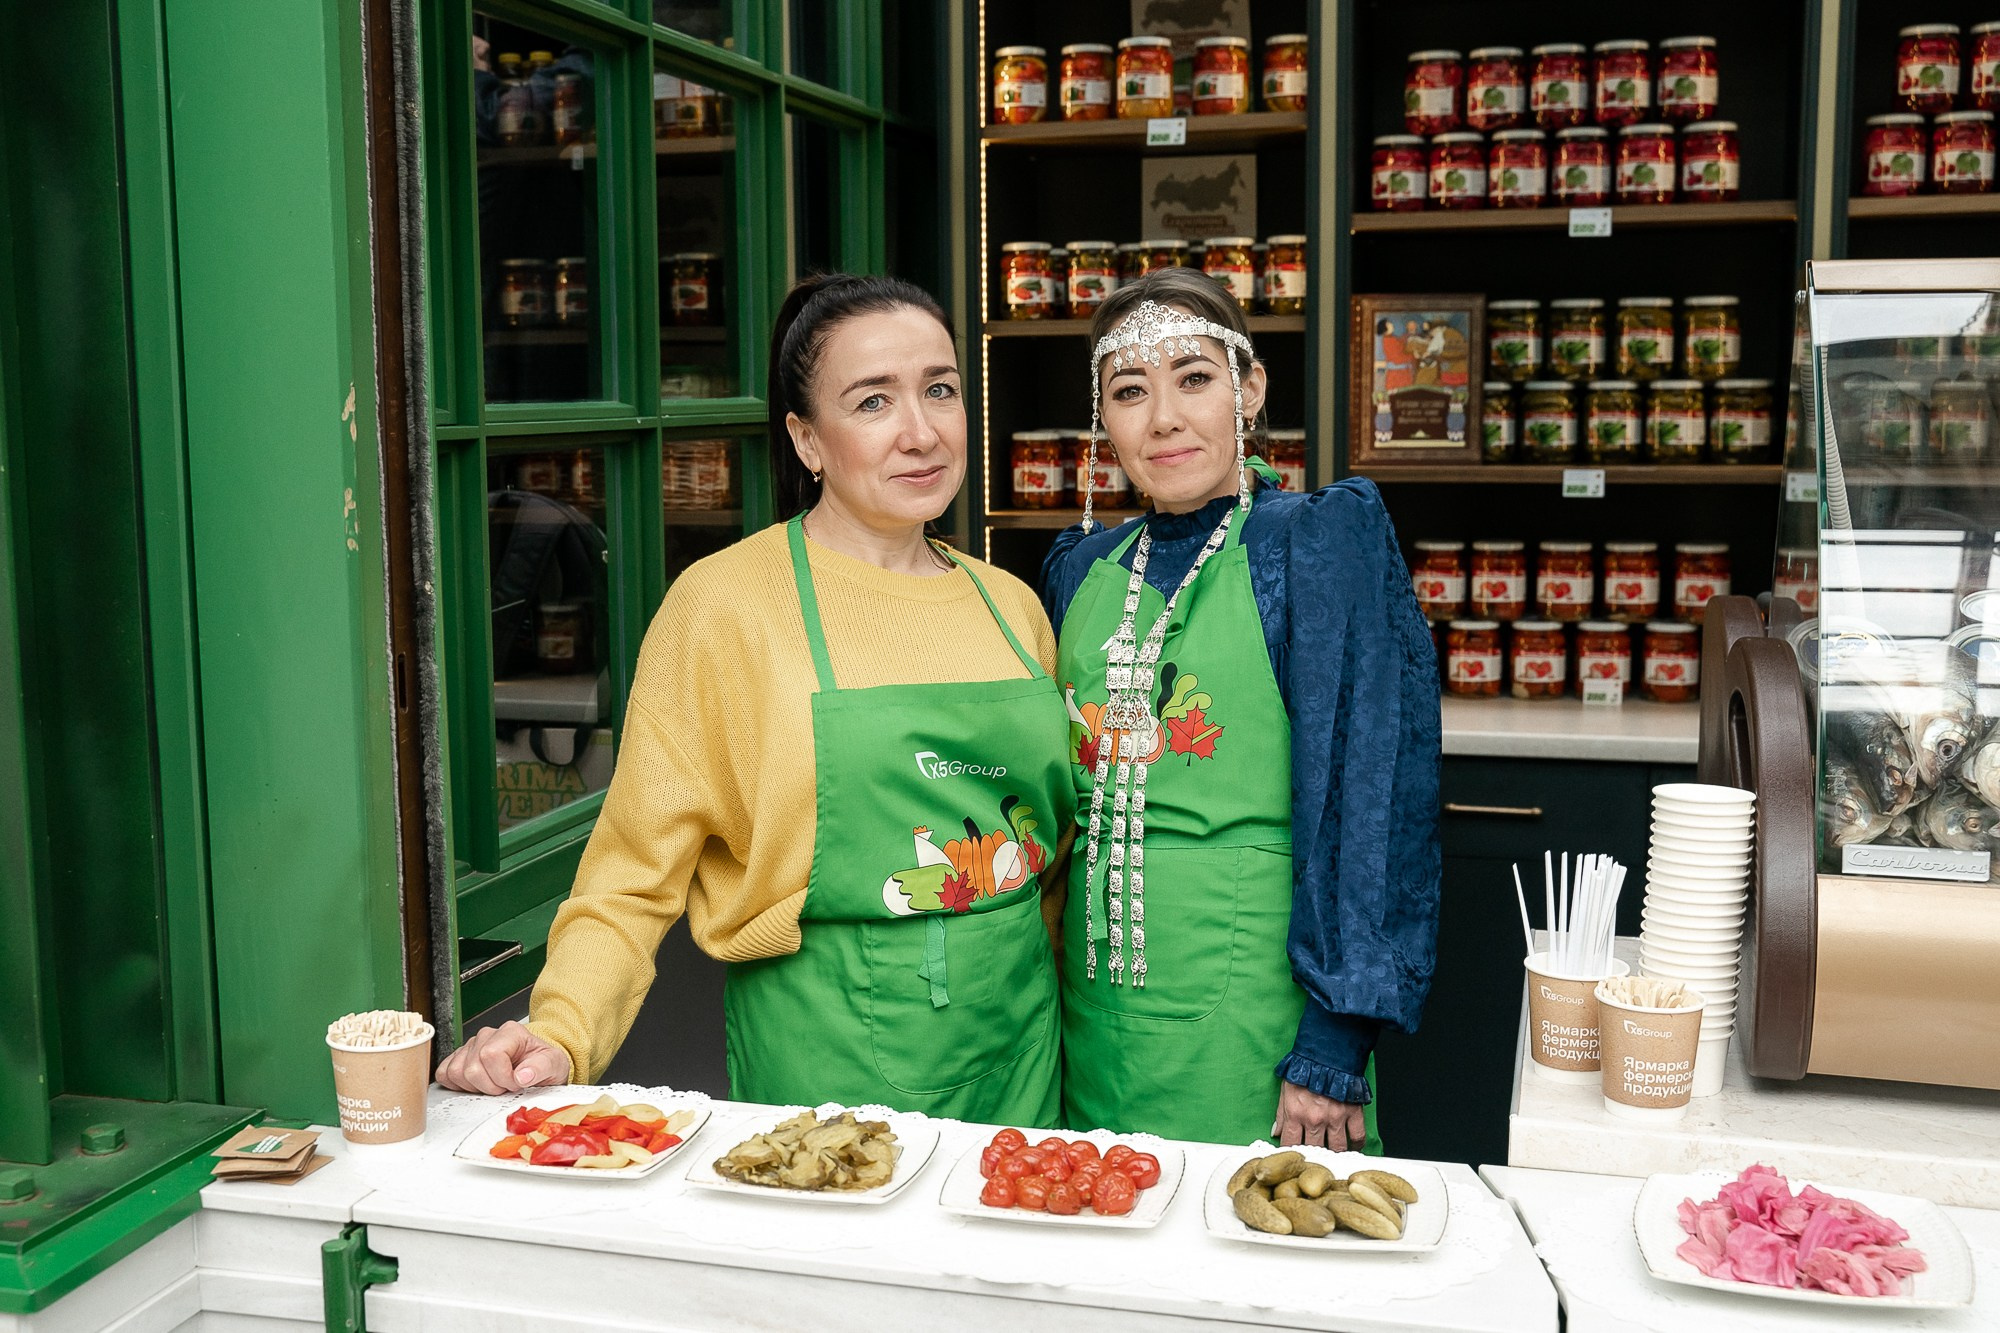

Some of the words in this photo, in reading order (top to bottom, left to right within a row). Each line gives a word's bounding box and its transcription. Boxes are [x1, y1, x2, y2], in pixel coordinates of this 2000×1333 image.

[928, 760, 1007, 780] X5Group
[1847, 850, 1988, 875] Carboma
[1541, 1031, 1600, 1050] фермер
[1623, 1055, 1690, 1075] Ярмарка
